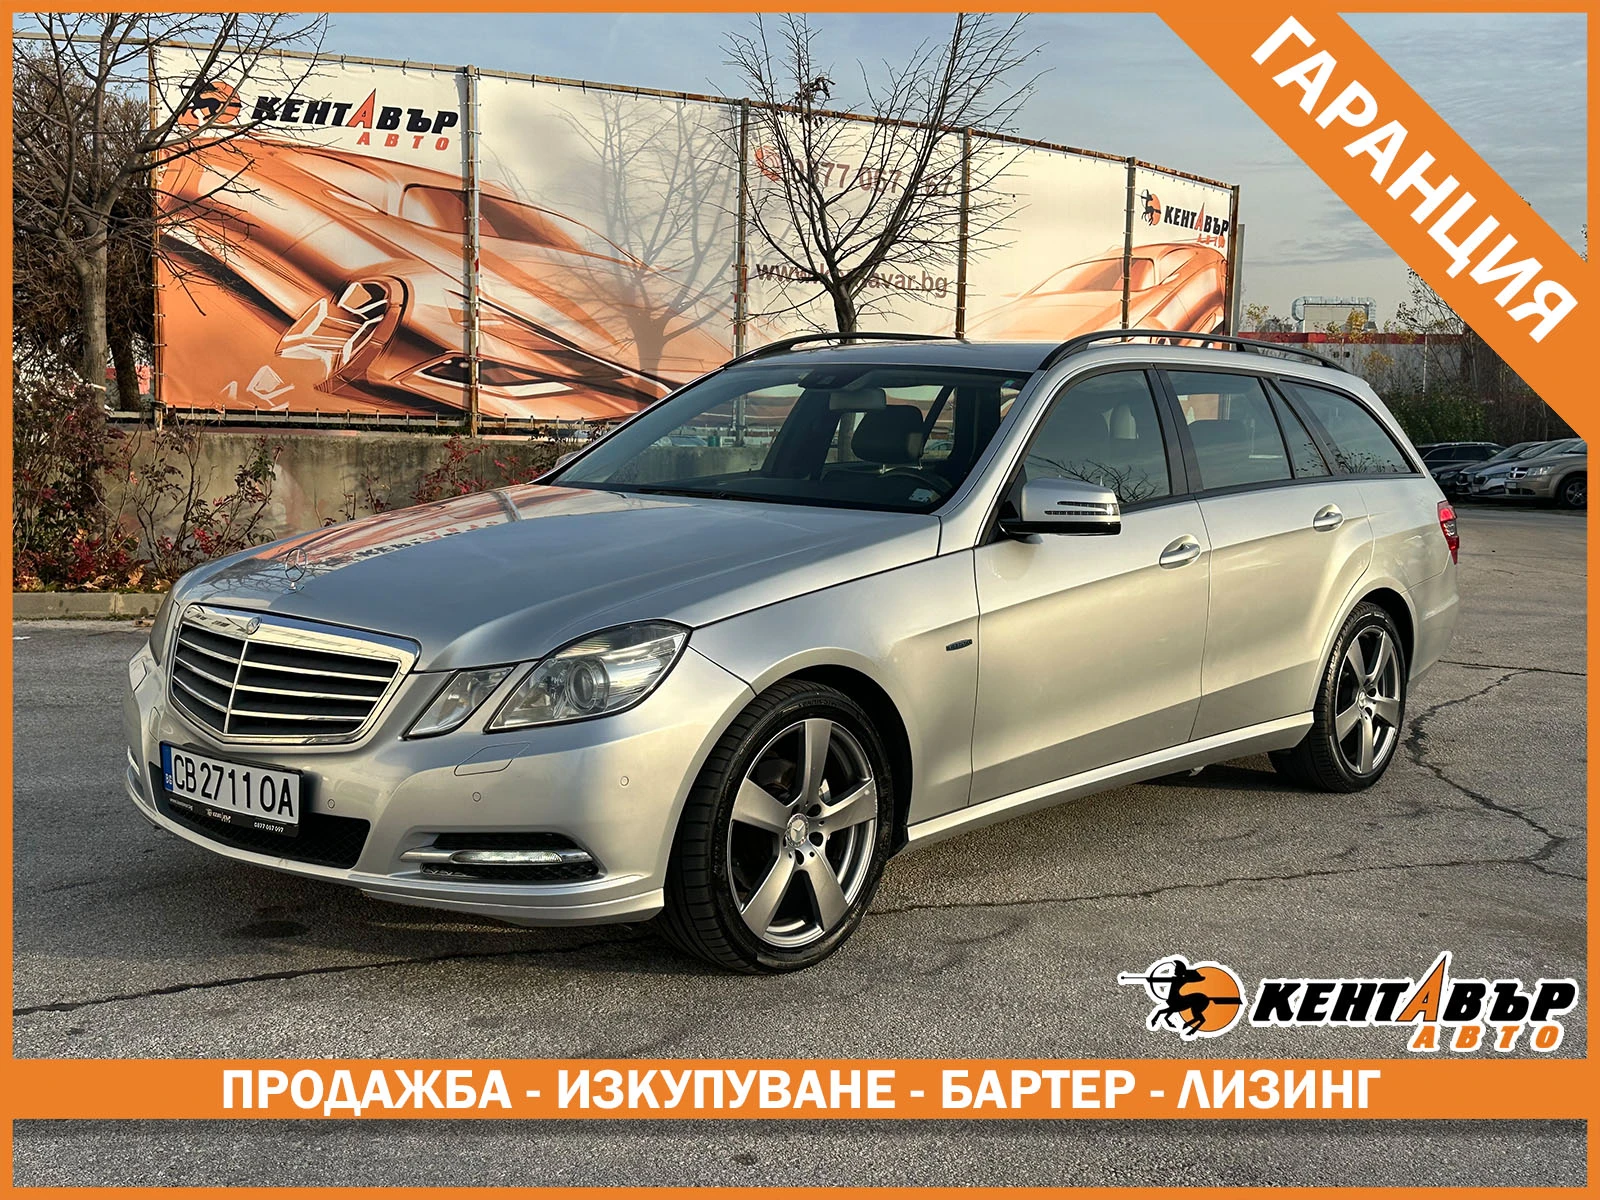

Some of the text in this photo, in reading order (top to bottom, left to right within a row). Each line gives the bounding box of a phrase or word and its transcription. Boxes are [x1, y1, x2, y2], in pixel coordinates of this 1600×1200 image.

[251, 88, 459, 134] КЕНТАВЪР
[356, 132, 450, 151] АВТО
[1163, 202, 1229, 236] КЕНТАВЪР
[200, 762, 251, 808] 2711
